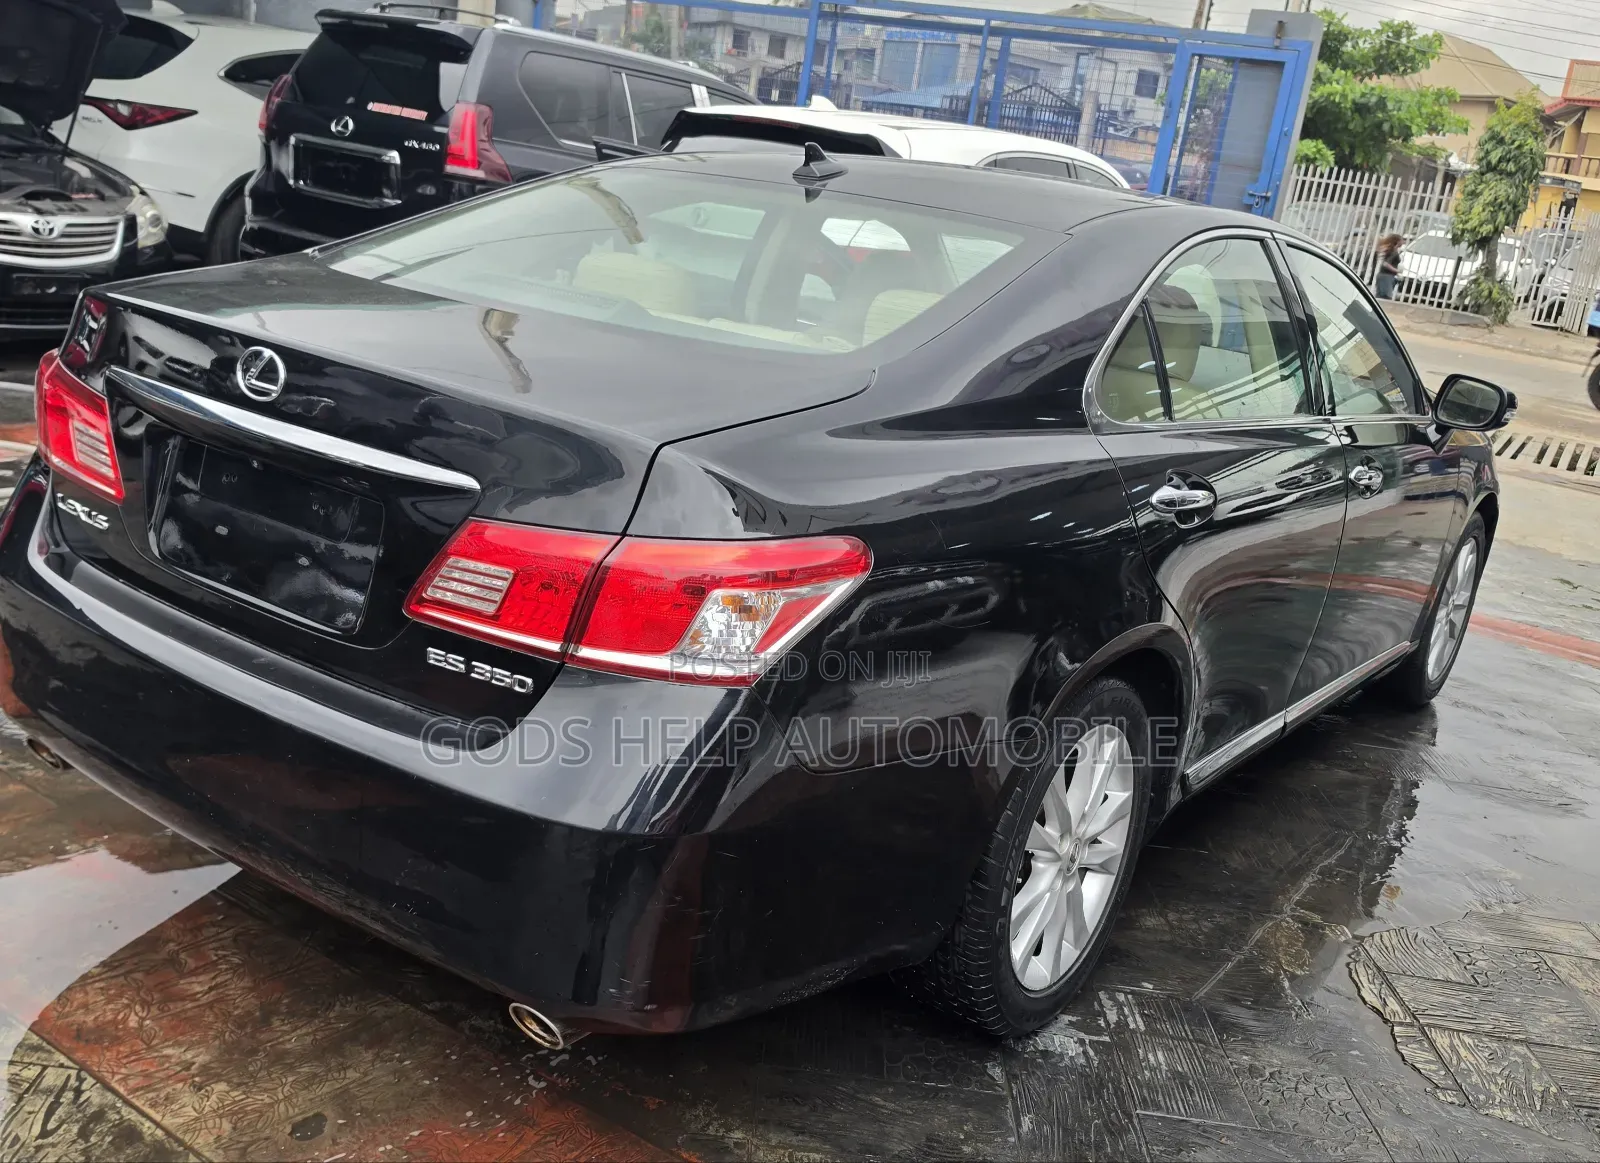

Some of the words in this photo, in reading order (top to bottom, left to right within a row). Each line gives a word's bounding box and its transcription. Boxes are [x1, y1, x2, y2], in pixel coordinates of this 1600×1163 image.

[56, 493, 109, 530] LEXUS
[426, 646, 466, 673] ES
[469, 661, 534, 694] 350
